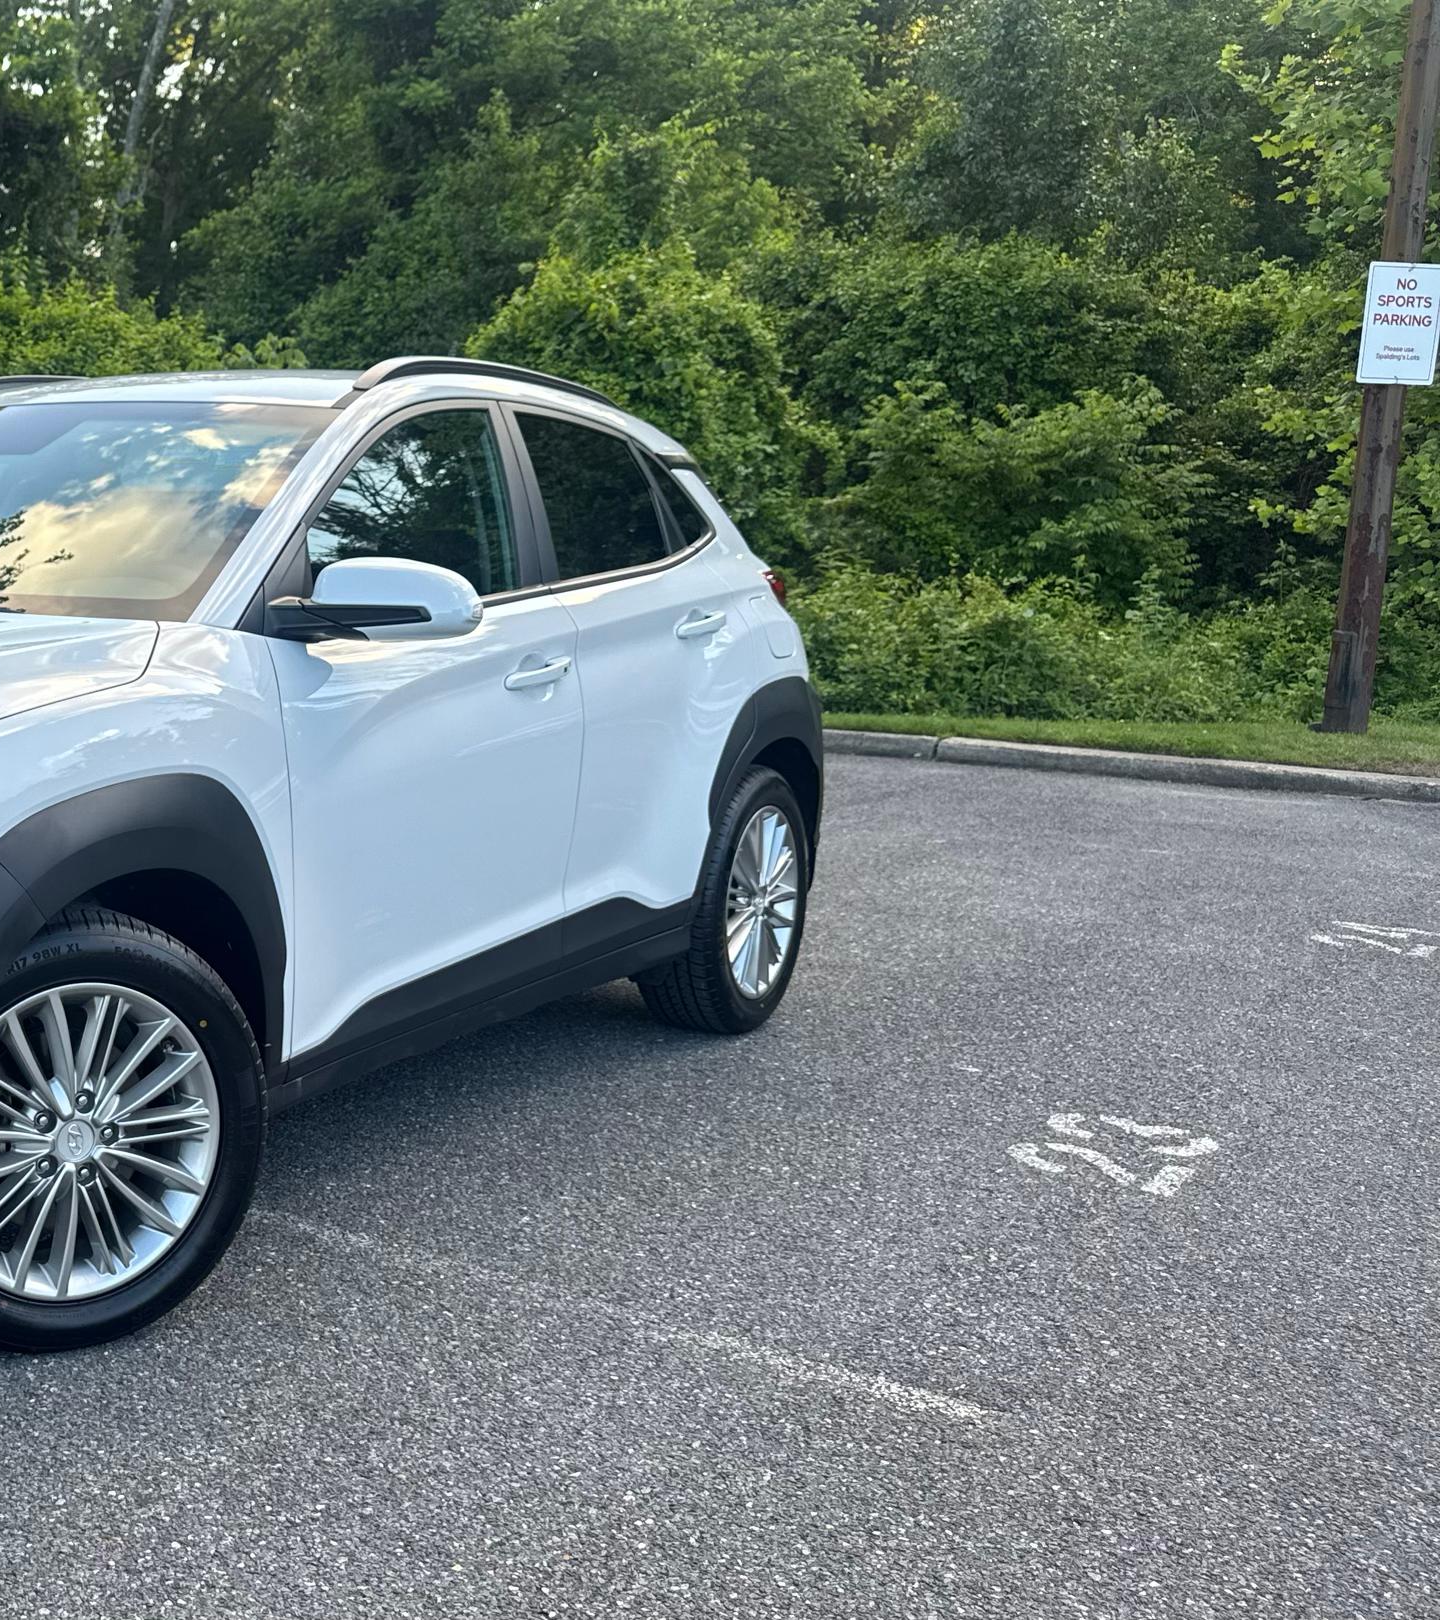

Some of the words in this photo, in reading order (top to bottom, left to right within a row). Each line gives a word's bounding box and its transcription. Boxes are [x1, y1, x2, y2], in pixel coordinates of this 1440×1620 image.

[1396, 278, 1417, 290] NO
[1377, 295, 1432, 308] SPORTS
[1373, 313, 1432, 327] PARKING
[32, 946, 61, 961] 98W
[66, 943, 82, 952] XL
